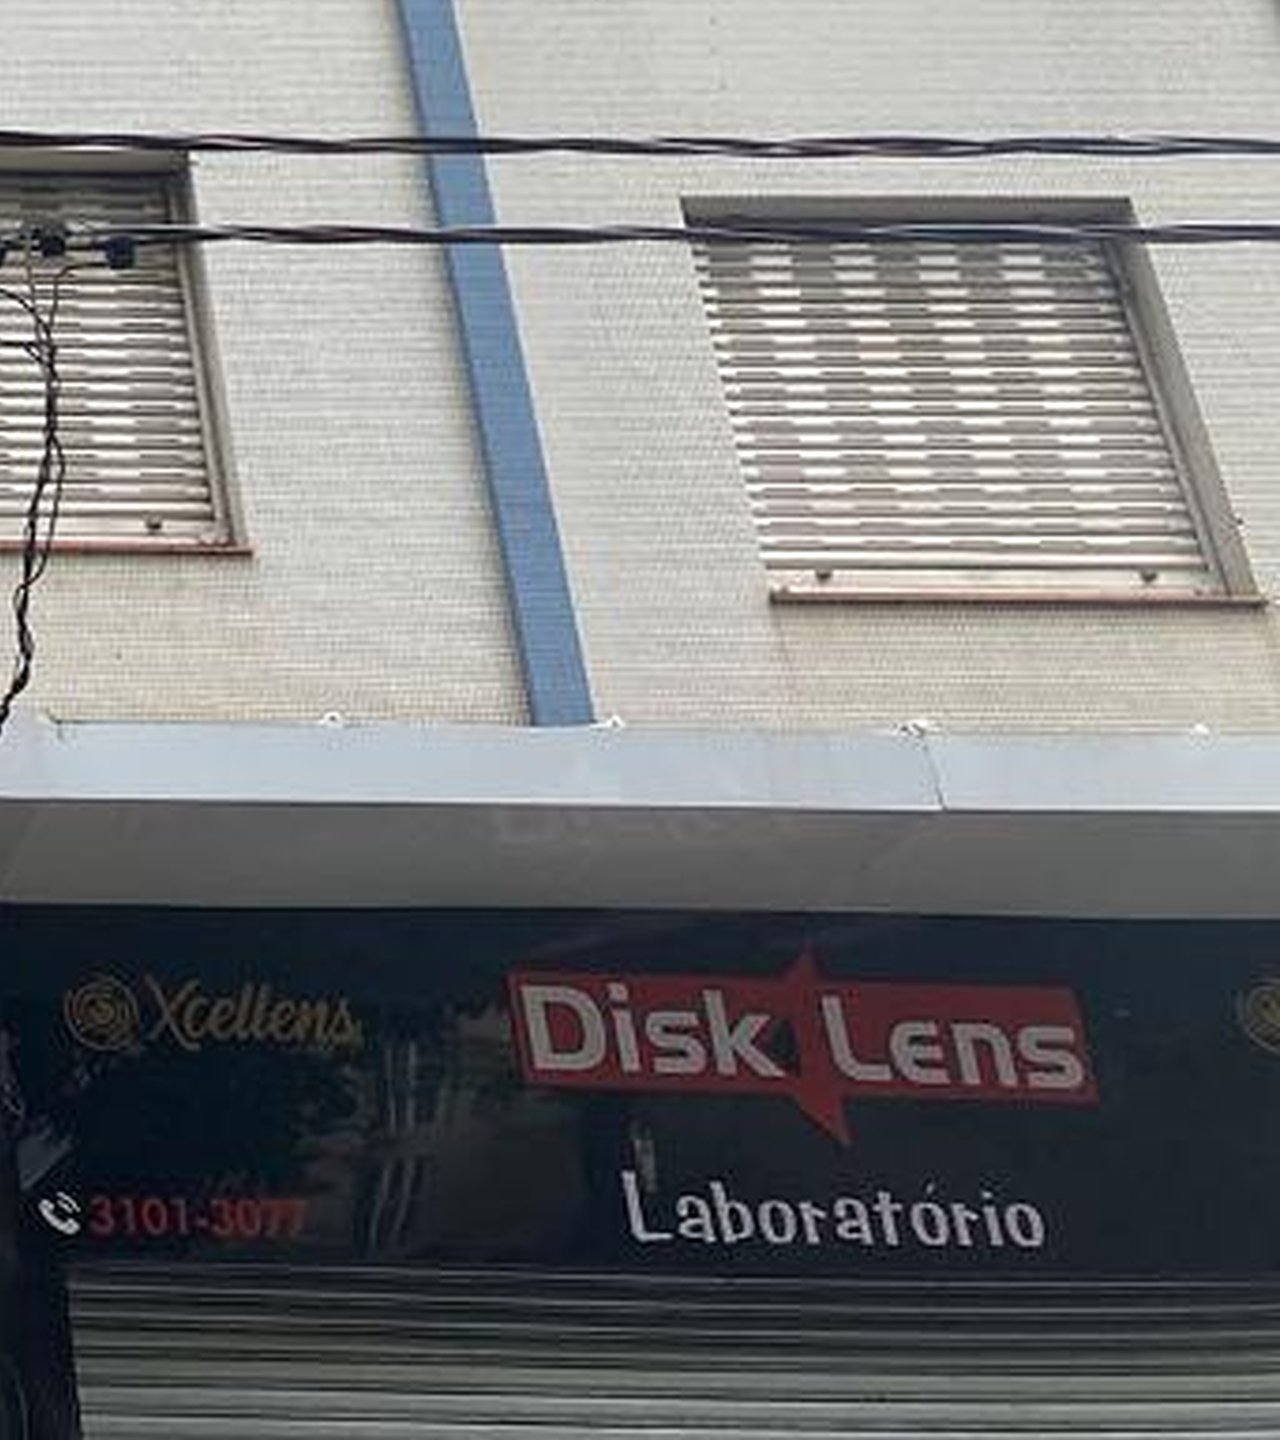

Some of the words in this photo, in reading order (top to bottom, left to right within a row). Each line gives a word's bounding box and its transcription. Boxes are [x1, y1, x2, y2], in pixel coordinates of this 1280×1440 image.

[143, 974, 363, 1051] Xcellens
[518, 981, 787, 1079] Disk
[820, 995, 1087, 1091] Lens
[90, 1195, 308, 1237] 3101-3077
[620, 1170, 1047, 1249] Laboratório
